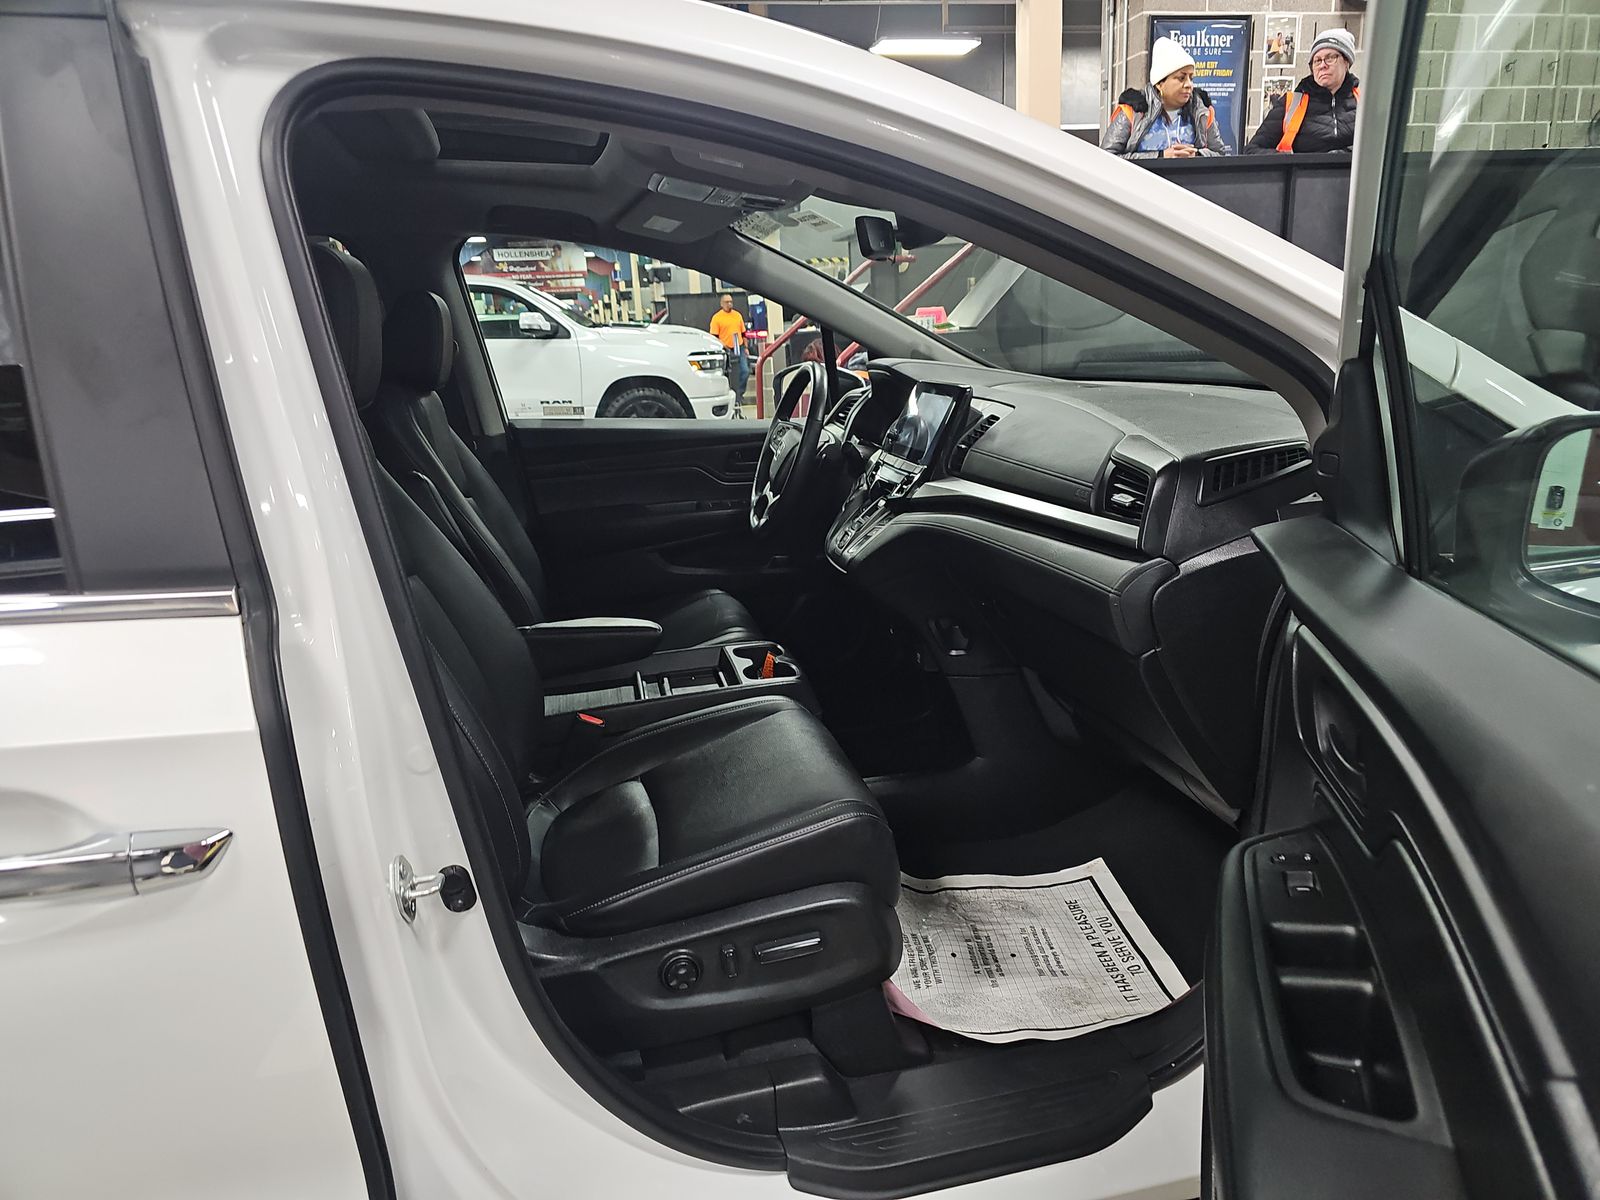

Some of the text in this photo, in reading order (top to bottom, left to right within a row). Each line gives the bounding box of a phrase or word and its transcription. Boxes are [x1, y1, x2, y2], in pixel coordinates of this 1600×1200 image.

[1169, 26, 1233, 48] Faulkner
[1193, 48, 1201, 56] BE
[1204, 48, 1222, 56] SURE
[1213, 69, 1233, 77] FRIDAY
[1064, 899, 1099, 940] PLEASURE
[975, 941, 989, 965] important
[1023, 936, 1040, 967] suggestions
[1029, 926, 1058, 977] improving our service
[1096, 916, 1144, 976] TO SERVE YOU
[907, 949, 916, 967] TRIED
[929, 956, 938, 967] THIS
[967, 944, 979, 969] customer
[988, 949, 998, 963] world
[1051, 951, 1064, 969] always
[1095, 950, 1119, 973] BEEN
[913, 980, 921, 990] WE
[922, 972, 932, 989] YOUR
[933, 970, 942, 984] WITH
[1110, 973, 1133, 992] HAS
